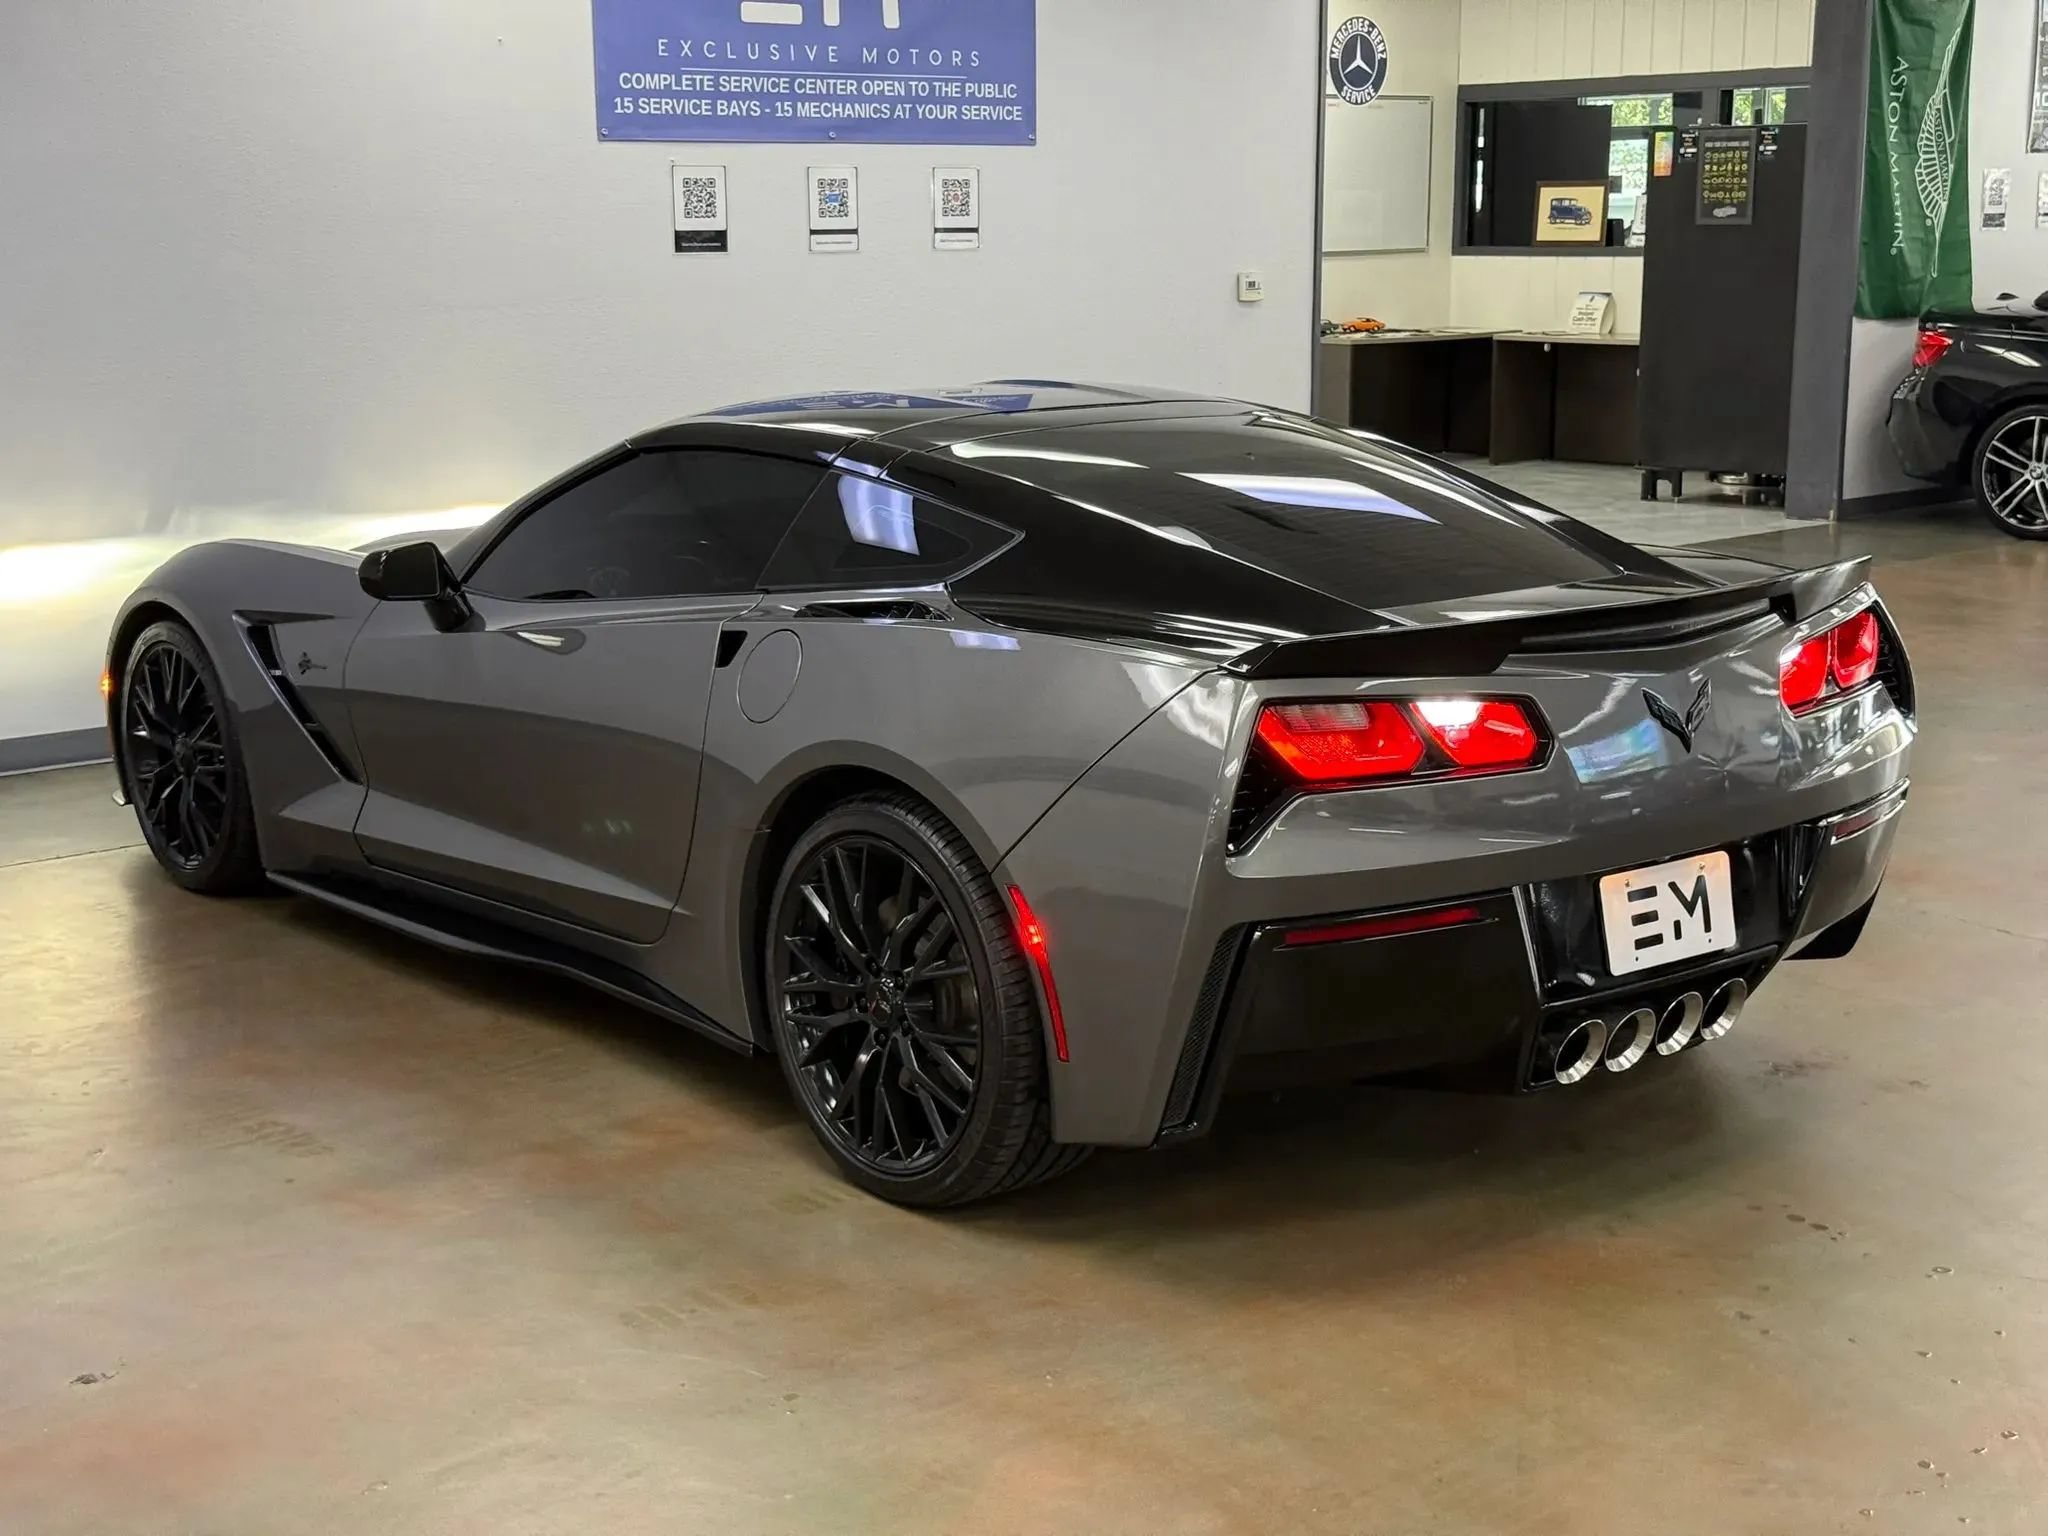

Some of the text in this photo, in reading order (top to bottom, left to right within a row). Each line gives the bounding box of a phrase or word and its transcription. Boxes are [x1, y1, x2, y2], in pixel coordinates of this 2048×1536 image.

[658, 39, 980, 66] EXCLUSIVE MOTORS
[619, 72, 1018, 98] COMPLETE SERVICE CENTER OPEN TO THE PUBLIC
[1341, 85, 1376, 103] SERVICE
[614, 97, 633, 113] 15
[638, 98, 712, 115] SERVICE
[717, 100, 761, 116] BAYS
[775, 102, 792, 117] 15
[797, 102, 890, 119] MECHANICS
[893, 104, 913, 119] AT
[915, 104, 957, 120] YOUR
[961, 105, 1023, 121] SERVICE
[1934, 111, 1945, 151] ASTON
[1888, 56, 1910, 247] ASTON MARTIN
[1627, 875, 1712, 951] EM
